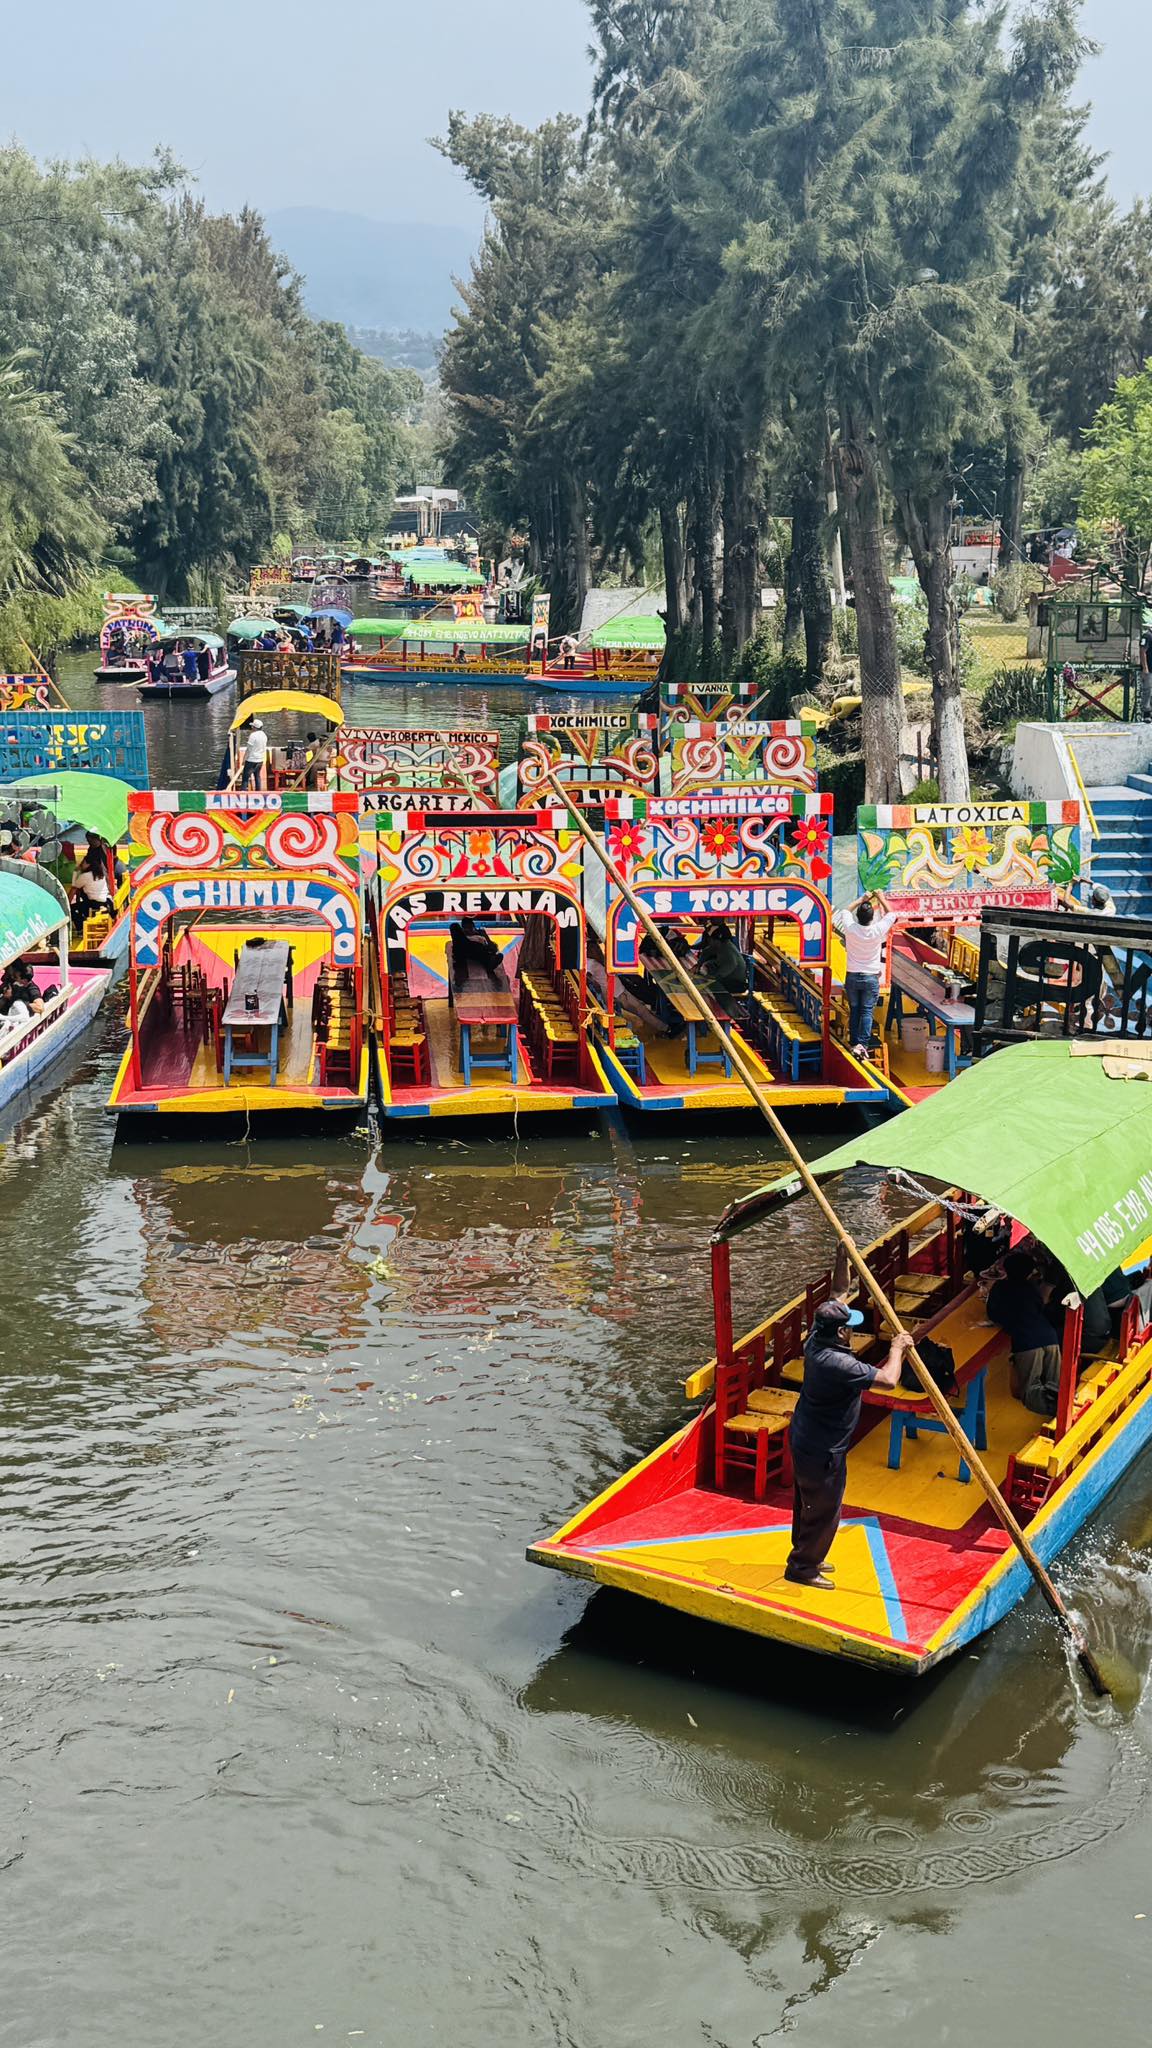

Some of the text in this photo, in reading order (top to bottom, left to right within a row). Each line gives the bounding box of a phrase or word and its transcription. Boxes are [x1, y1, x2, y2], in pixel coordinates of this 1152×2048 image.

[691, 684, 729, 693] IVANNA
[551, 716, 627, 727] XOCHIMILCO
[716, 722, 771, 736] LINDA
[342, 730, 488, 743] VIVA ROBERTO MEXICO
[206, 793, 282, 810] LINDO
[363, 794, 473, 811] ARGARITA
[650, 797, 789, 816] XOCHIMILCO
[135, 879, 357, 957] XOCHIMILCO
[388, 890, 579, 949] LAS REYNAS
[689, 889, 822, 941] TOXICAS
